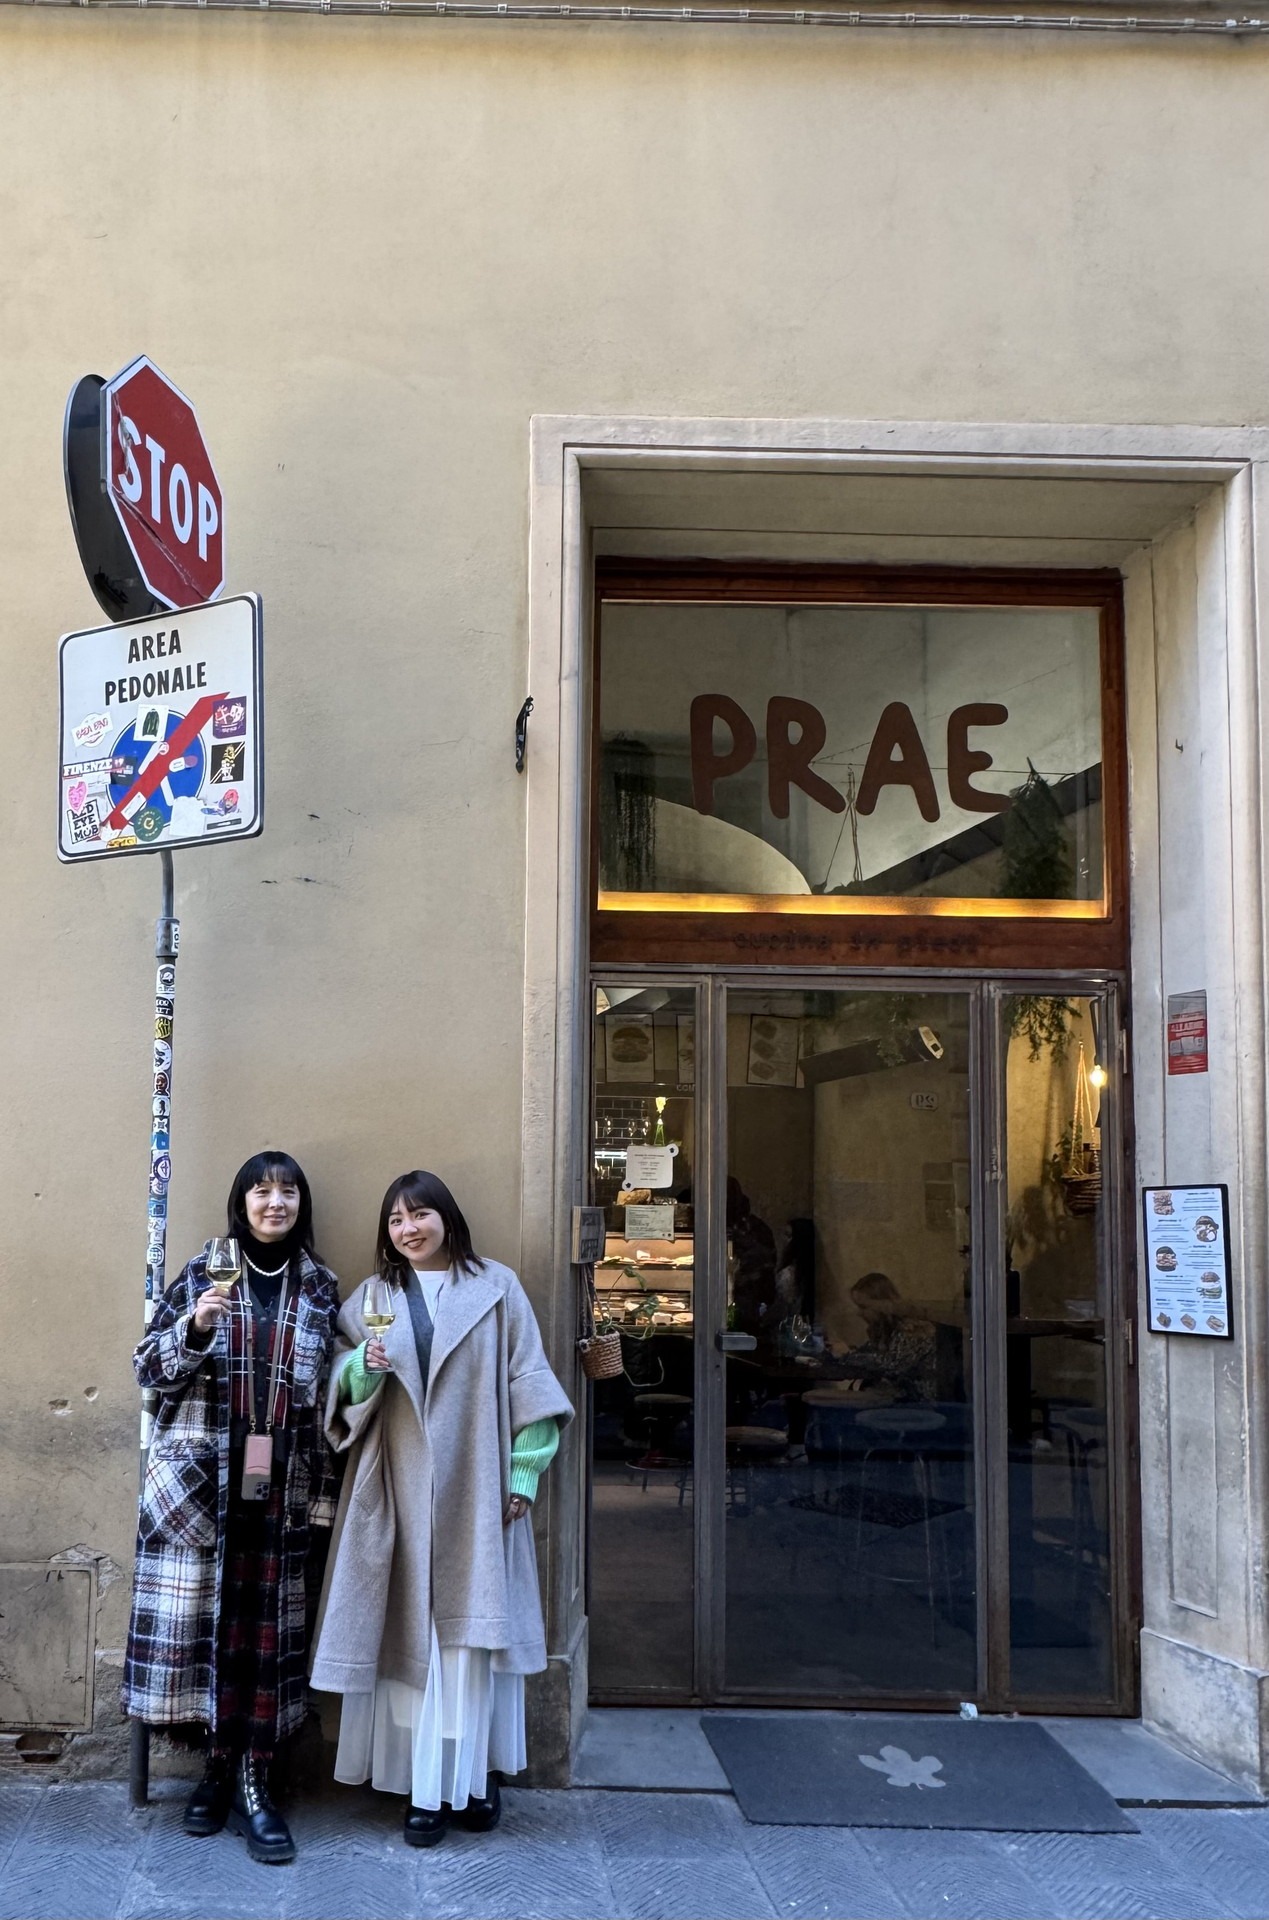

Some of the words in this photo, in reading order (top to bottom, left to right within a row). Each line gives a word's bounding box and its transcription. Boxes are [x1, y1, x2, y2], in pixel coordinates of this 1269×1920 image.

[117, 415, 219, 562] STOP
[127, 629, 182, 664] AREA
[105, 661, 207, 706] PEDONALE
[63, 757, 113, 777] FIRENZE
[689, 693, 1013, 823] PRAE
[73, 813, 96, 831] EYE
